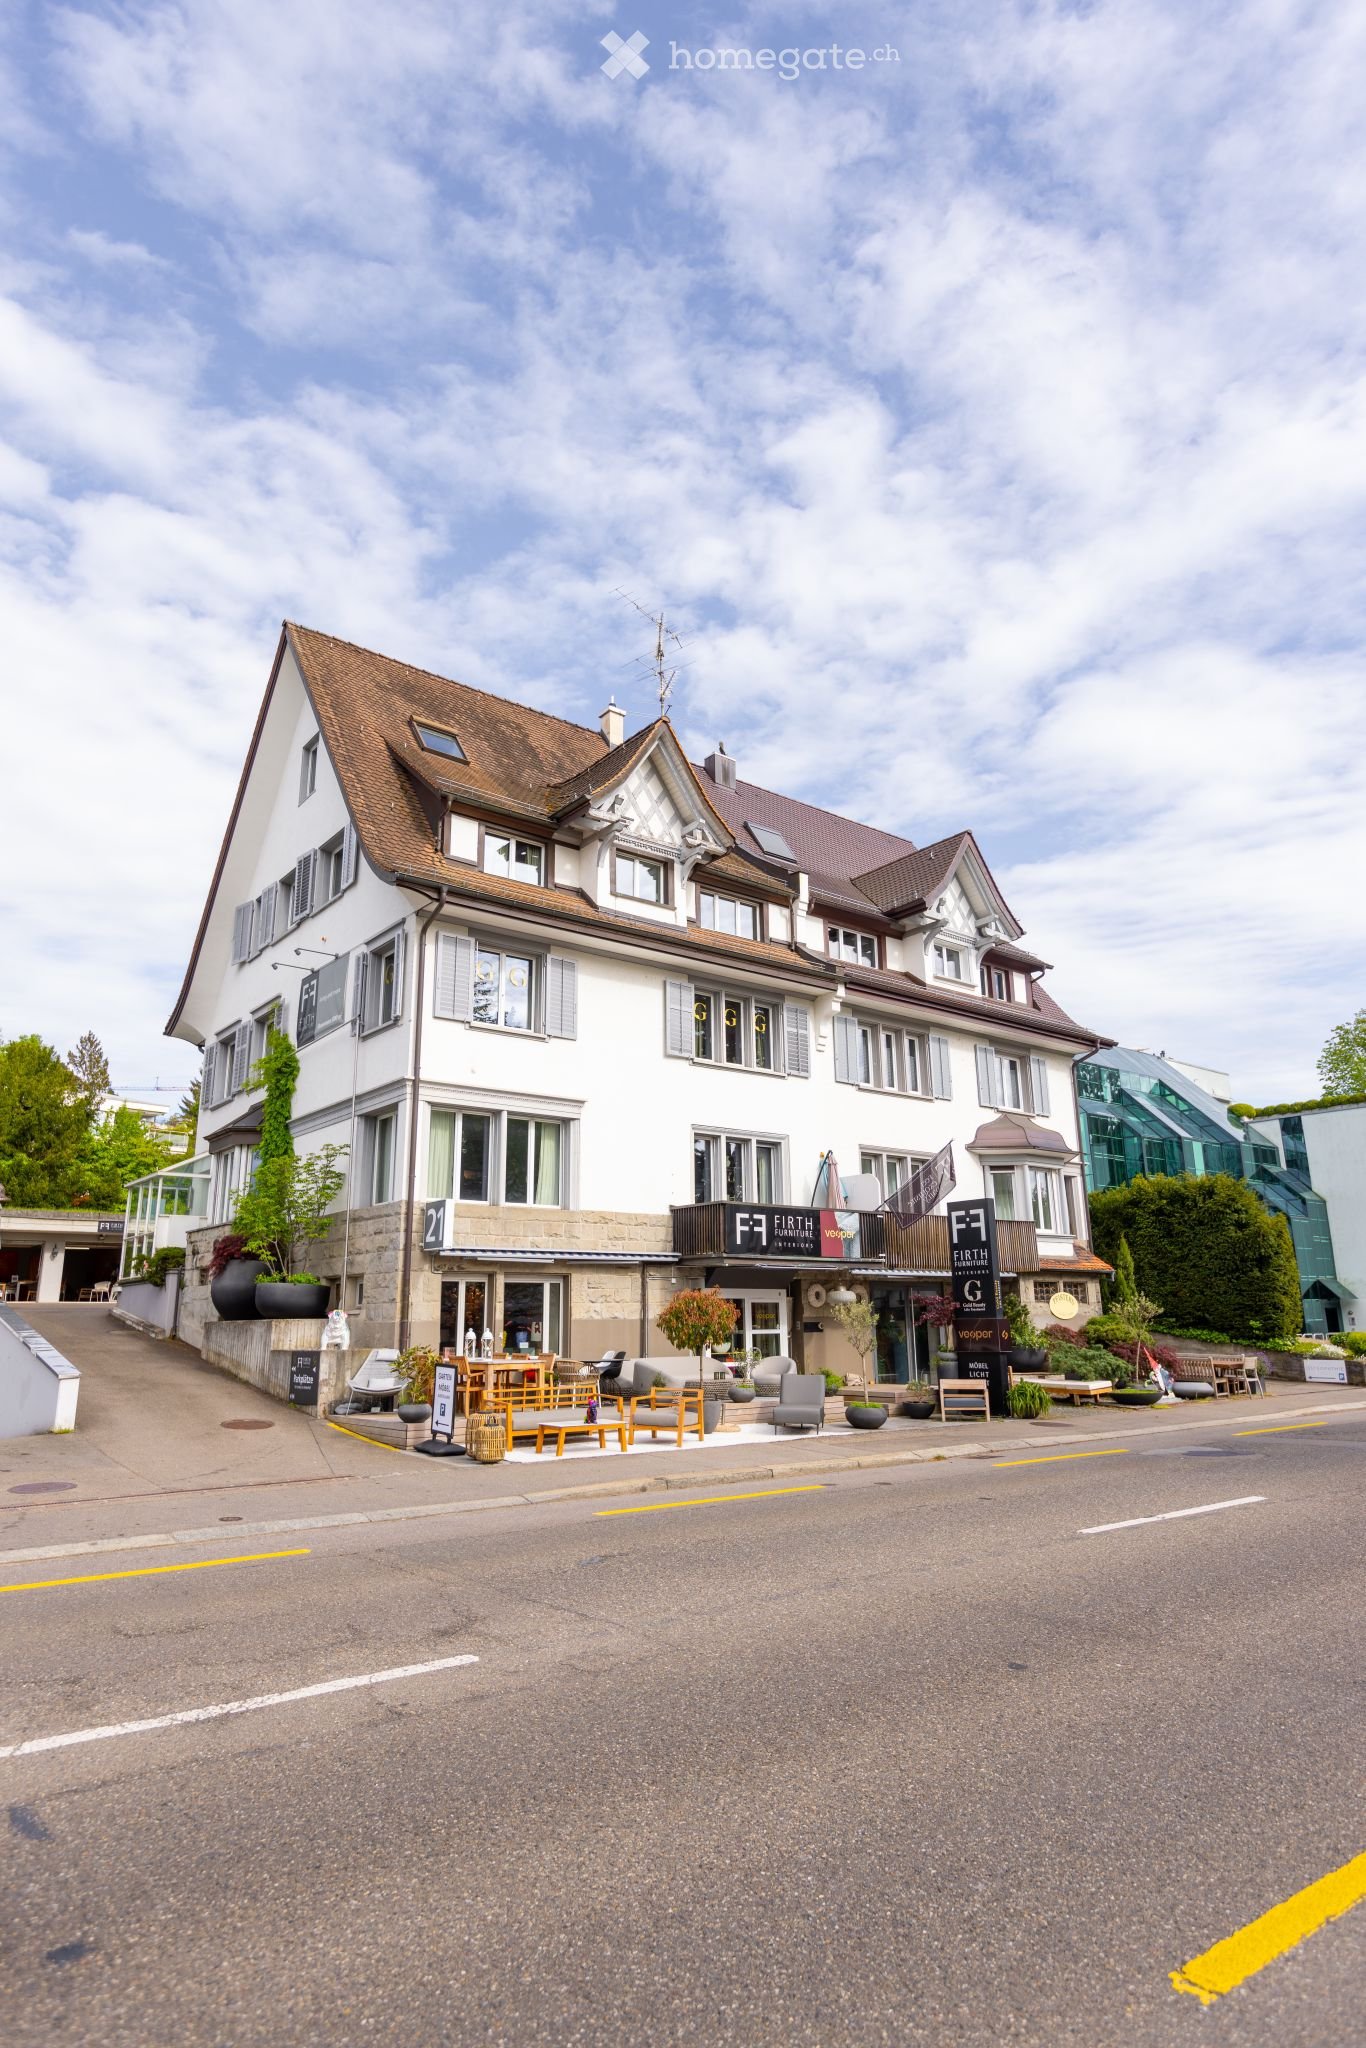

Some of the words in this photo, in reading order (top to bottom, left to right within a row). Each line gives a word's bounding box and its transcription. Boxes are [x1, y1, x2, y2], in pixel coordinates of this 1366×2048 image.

[694, 1003, 707, 1021] G
[724, 1009, 737, 1027] G
[755, 1014, 767, 1033] G
[425, 1207, 444, 1242] 21
[774, 1215, 813, 1230] FIRTH
[774, 1229, 813, 1238] FURNITURE
[774, 1241, 813, 1249] INTERIORS
[953, 1248, 988, 1261] FIRTH
[954, 1259, 989, 1268] FURNITURE
[964, 1279, 983, 1301] G
[969, 1361, 989, 1369] MÖBEL
